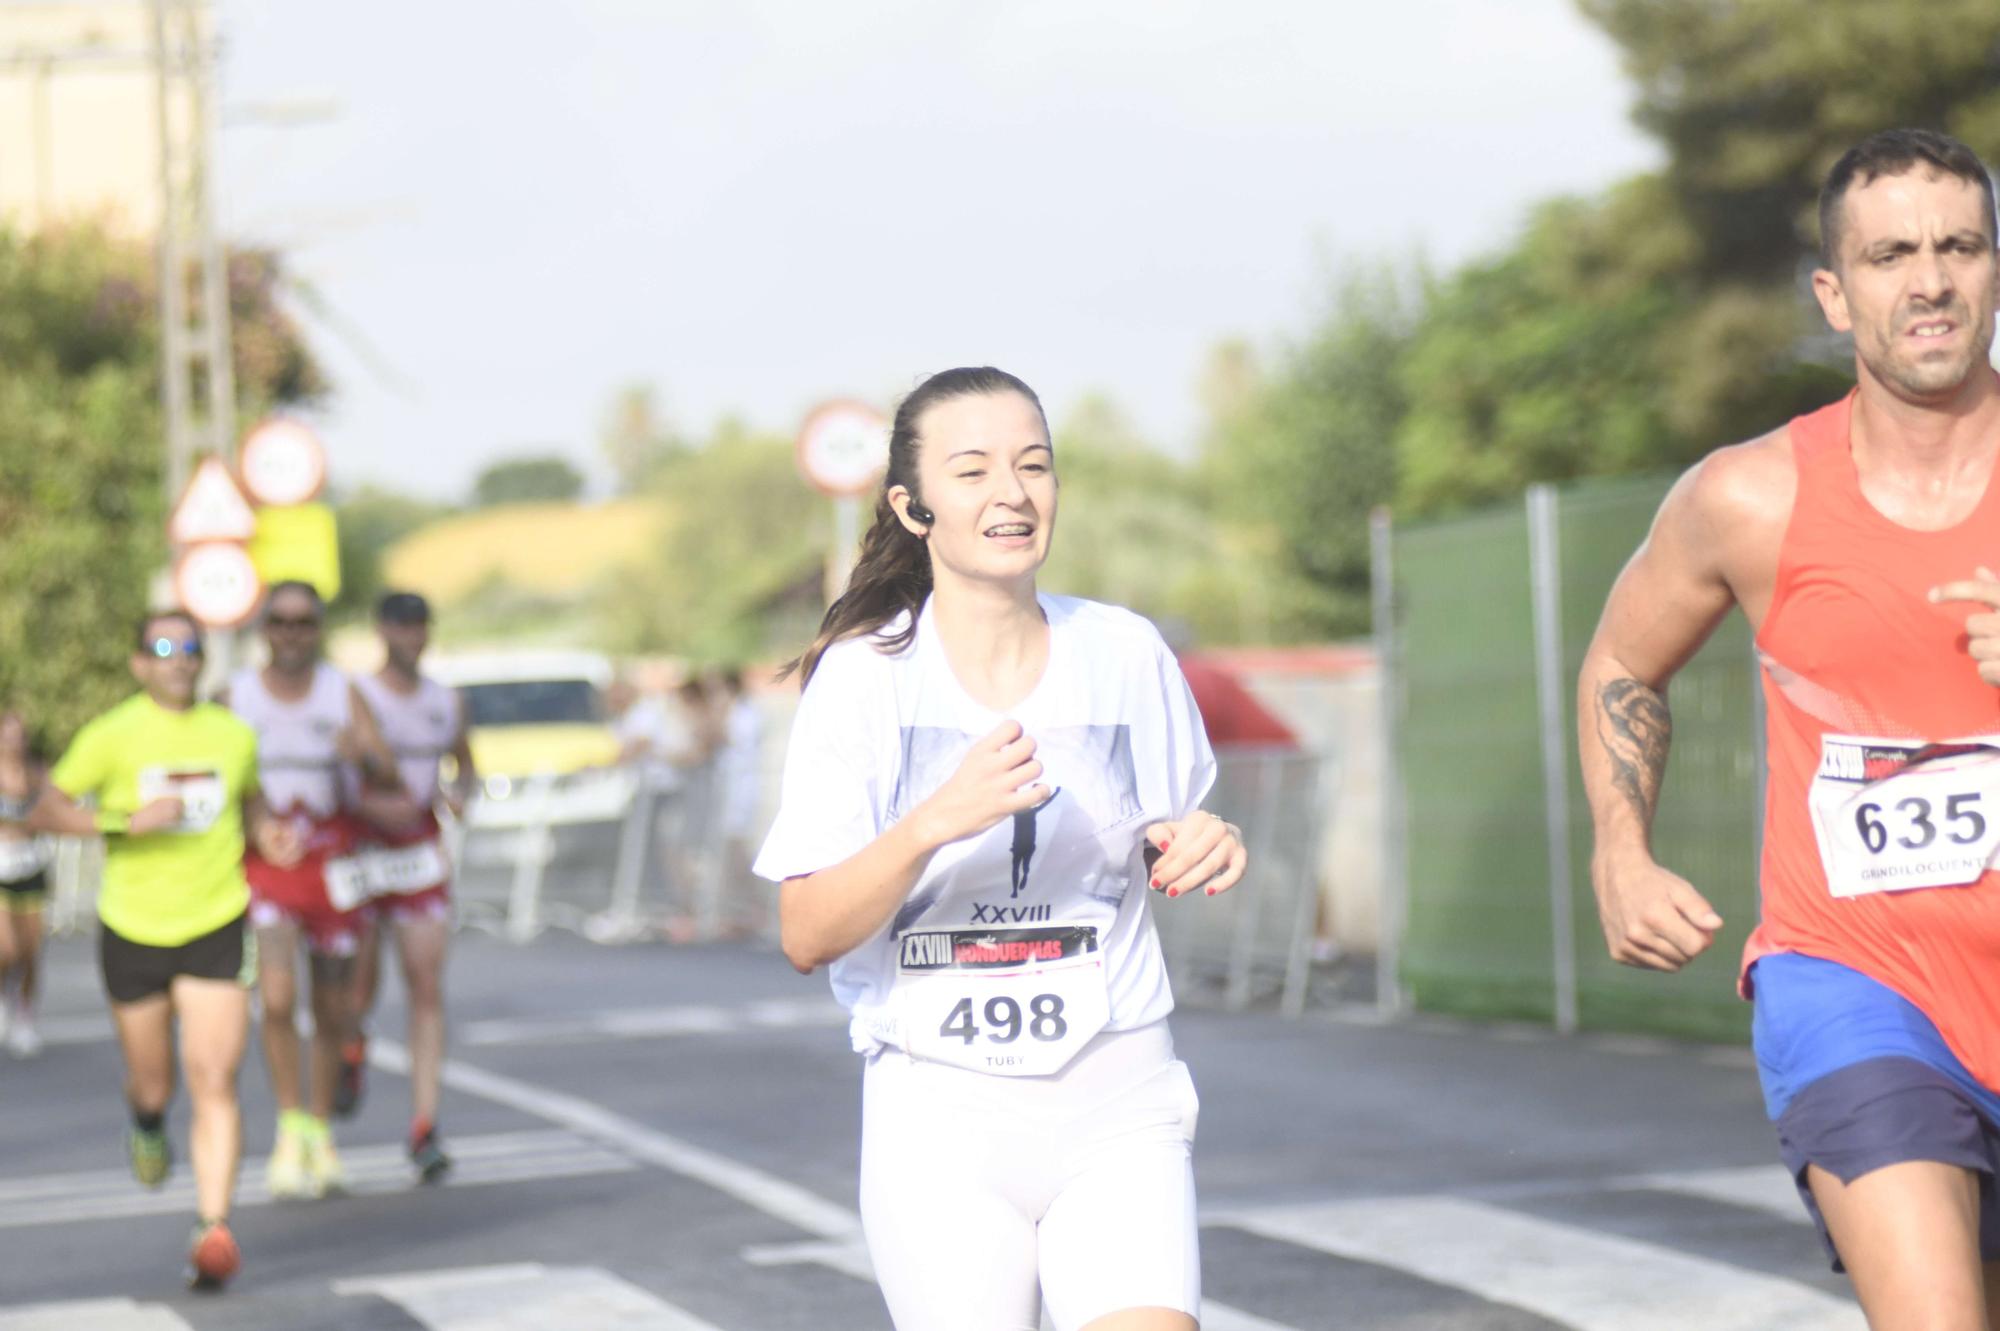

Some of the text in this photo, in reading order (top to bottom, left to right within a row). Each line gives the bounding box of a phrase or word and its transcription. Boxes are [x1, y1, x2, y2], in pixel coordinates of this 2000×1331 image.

[1855, 792, 1986, 855] 635
[970, 902, 1052, 923] XXVIII
[902, 933, 952, 966] XXVIII
[939, 993, 1068, 1045] 498
[985, 1056, 1025, 1067] TUBY
